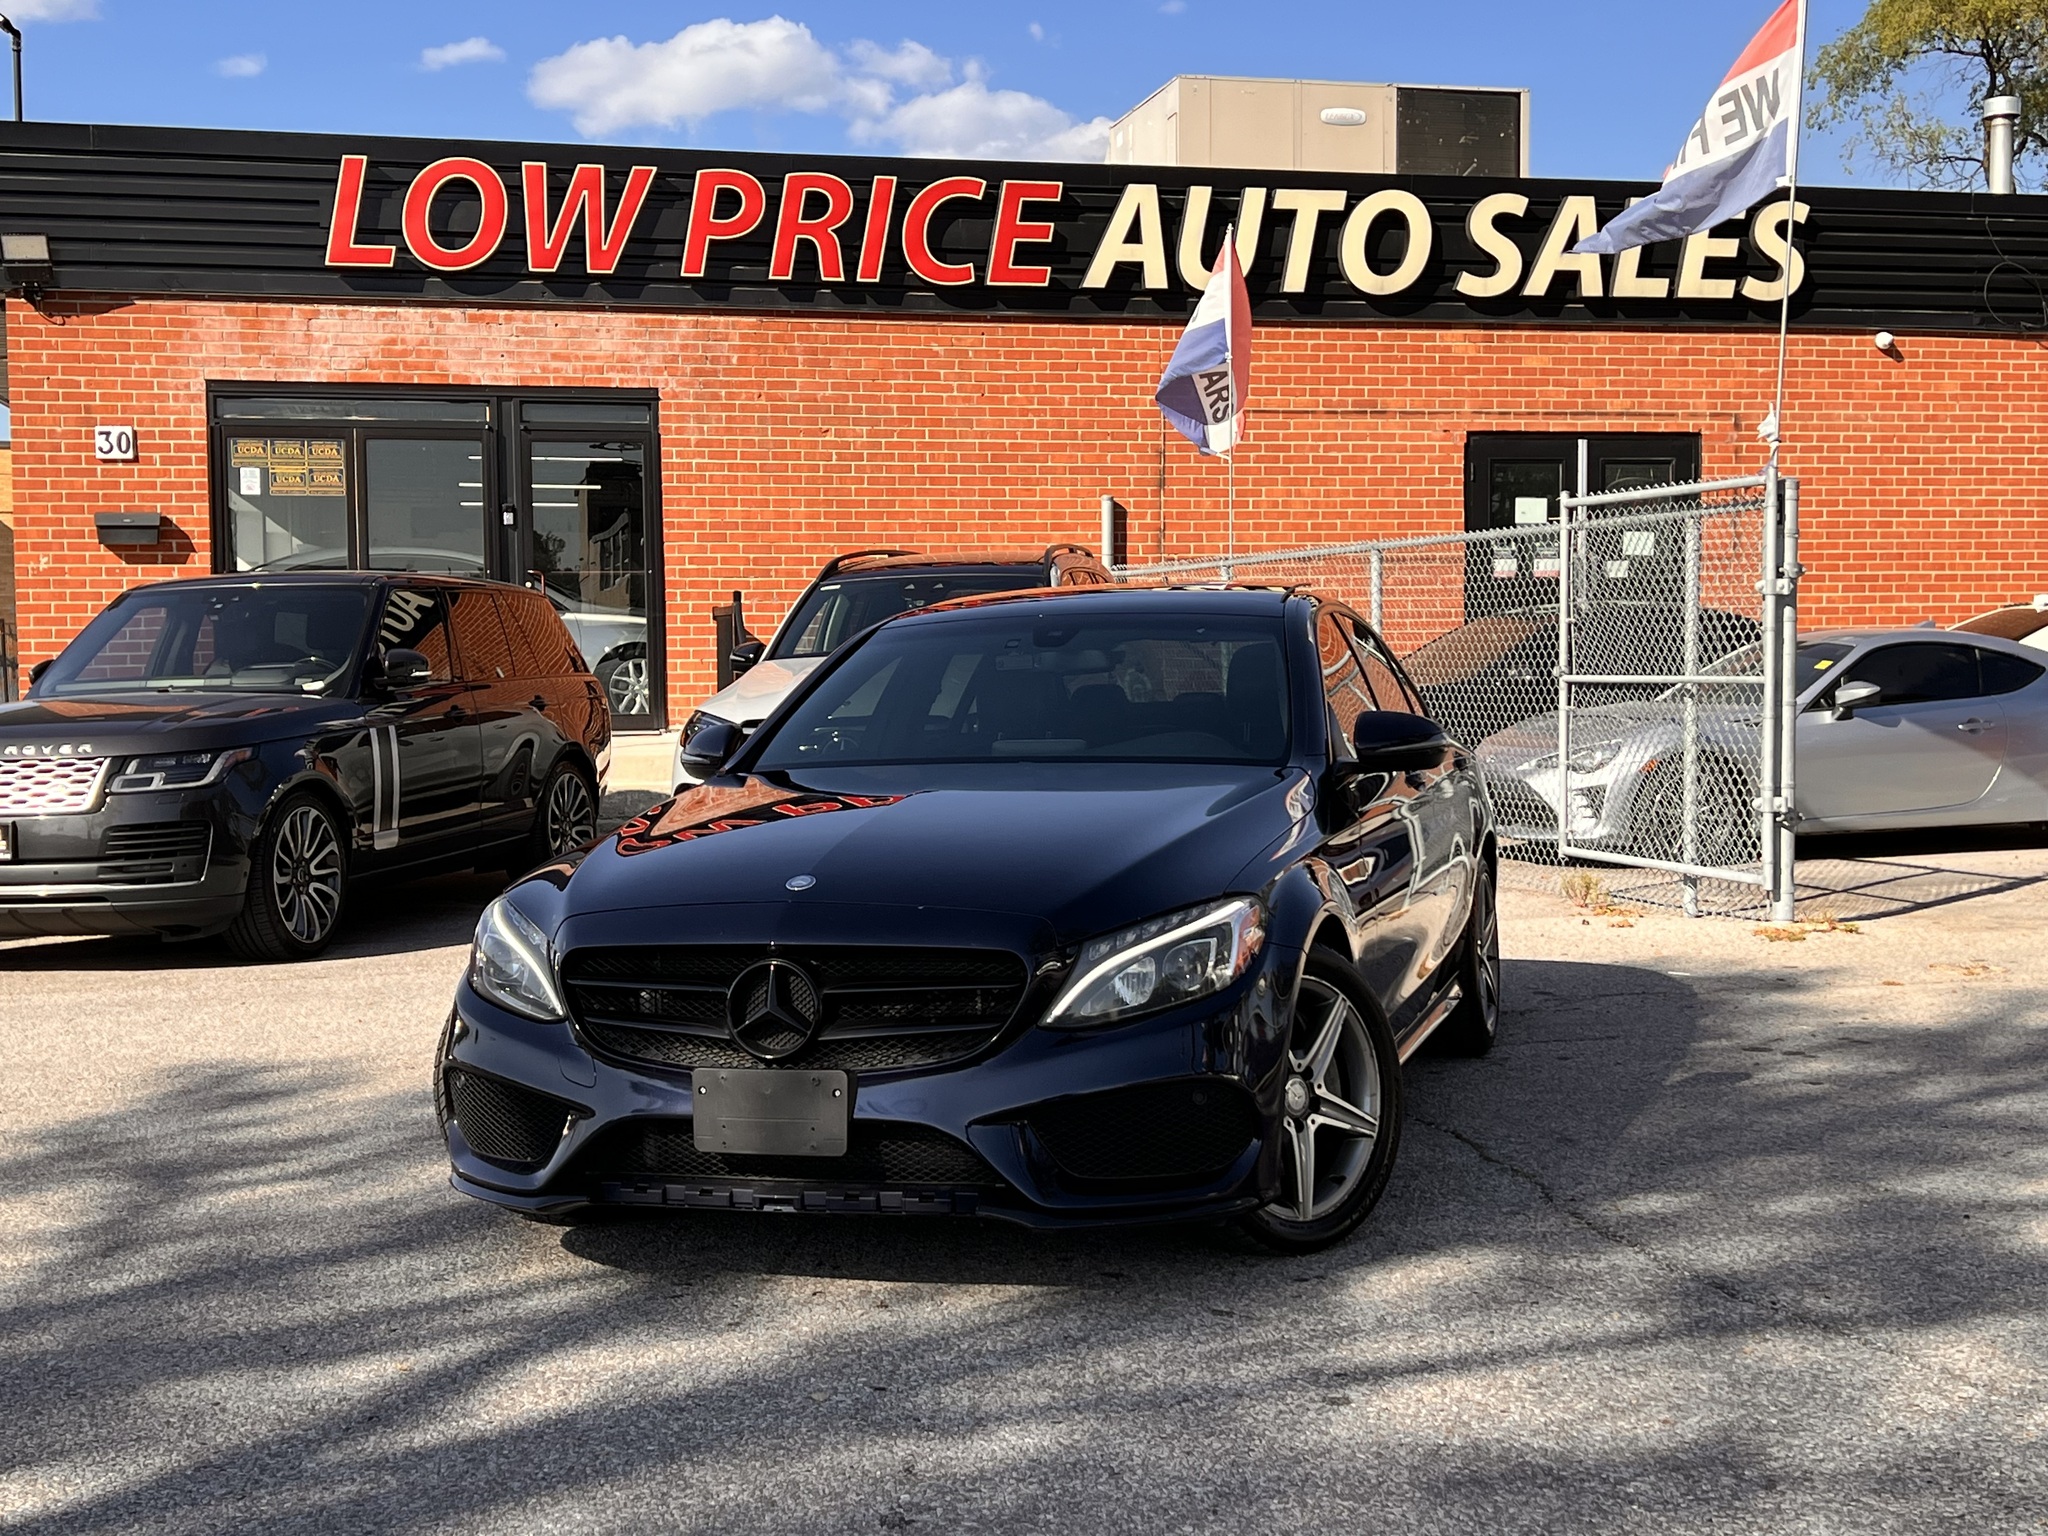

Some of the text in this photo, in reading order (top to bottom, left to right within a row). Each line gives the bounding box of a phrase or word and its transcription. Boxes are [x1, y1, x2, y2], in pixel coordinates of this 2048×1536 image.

[325, 154, 1810, 302] LOW PRICE AUTO SALES
[97, 430, 131, 455] 30
[237, 446, 264, 454] UCDA
[275, 447, 302, 455] UCDA
[312, 448, 338, 456] UCDA
[276, 475, 302, 483] UCDA
[313, 474, 340, 483] UCDA
